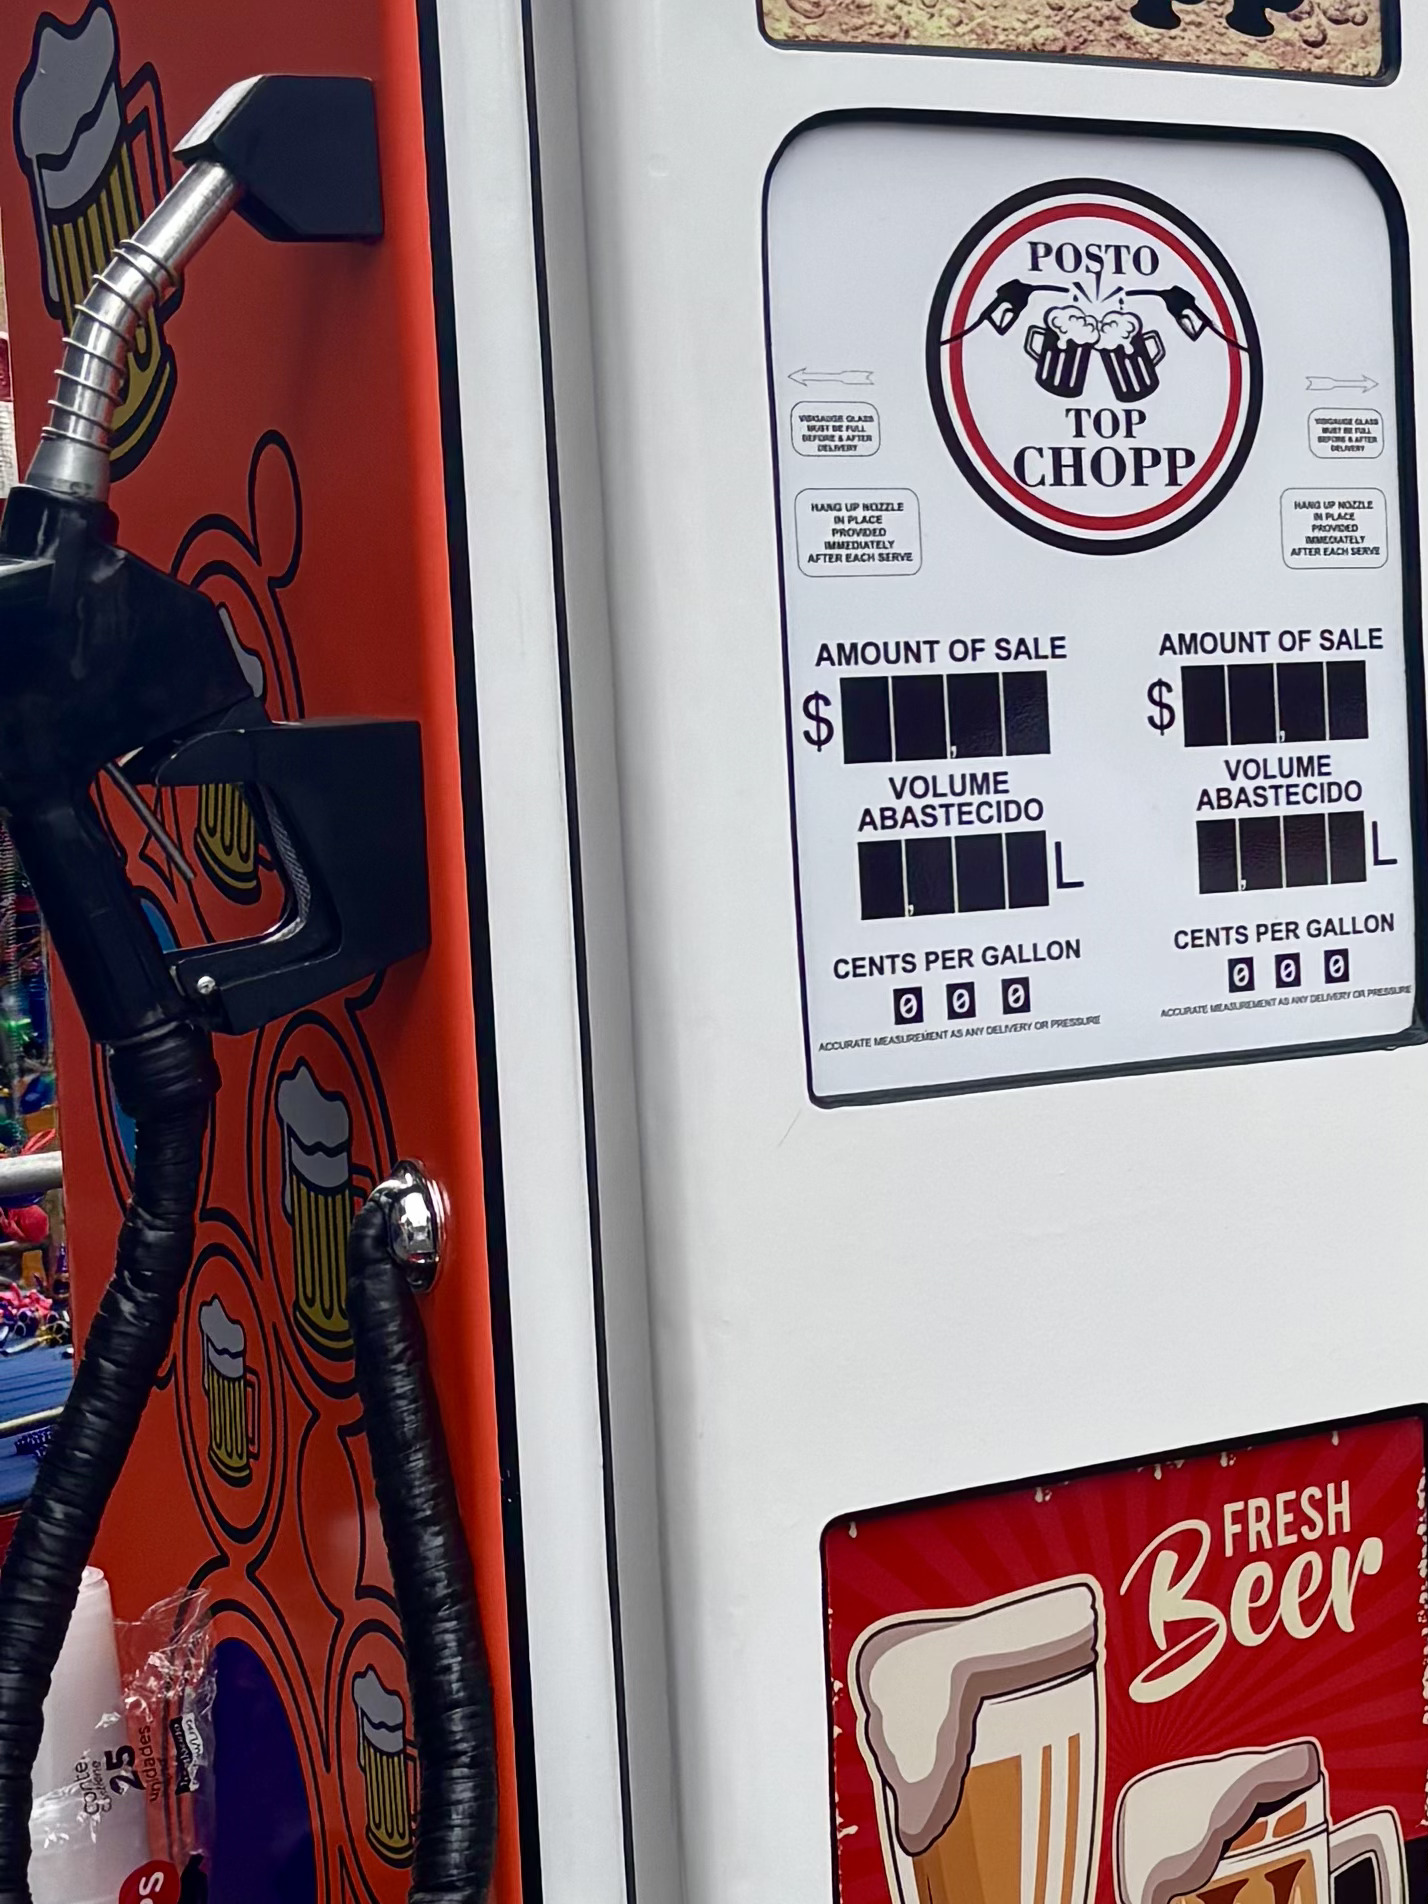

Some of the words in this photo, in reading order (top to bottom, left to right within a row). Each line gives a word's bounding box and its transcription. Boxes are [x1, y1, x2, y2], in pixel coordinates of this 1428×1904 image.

[1027, 240, 1160, 277] POSTO
[1065, 407, 1147, 441] TOP
[1014, 446, 1196, 488] CHOPP
[832, 528, 886, 537] PROVIDED
[848, 515, 882, 524] PLACE
[808, 553, 842, 563] AFTER
[845, 553, 875, 562] EACH
[878, 552, 913, 562] SERVE
[815, 639, 941, 668] AMOUNT
[949, 638, 986, 663] OF
[994, 636, 1068, 662] SALE
[1159, 631, 1270, 657] AMOUNT
[1278, 629, 1313, 652] OF
[1320, 627, 1384, 650] SALE
[801, 690, 835, 752] $
[1147, 678, 1176, 736] $
[889, 771, 1010, 800] VOLUME
[1224, 755, 1333, 781] VOLUME
[1196, 781, 1363, 811] ABASTECIDO
[858, 799, 1044, 832] ABASTECIDO
[1372, 820, 1398, 866] L
[1054, 840, 1085, 889] L
[1173, 925, 1248, 951] CENTS
[1256, 922, 1300, 943] PER
[1306, 913, 1395, 941] GALLON
[833, 952, 918, 980] CENTS
[924, 948, 974, 973] PER
[981, 938, 1082, 968] GALLON
[1223, 1479, 1352, 1559] FRESH
[1119, 1517, 1383, 1705] Beer
[104, 1745, 146, 1795] 25
